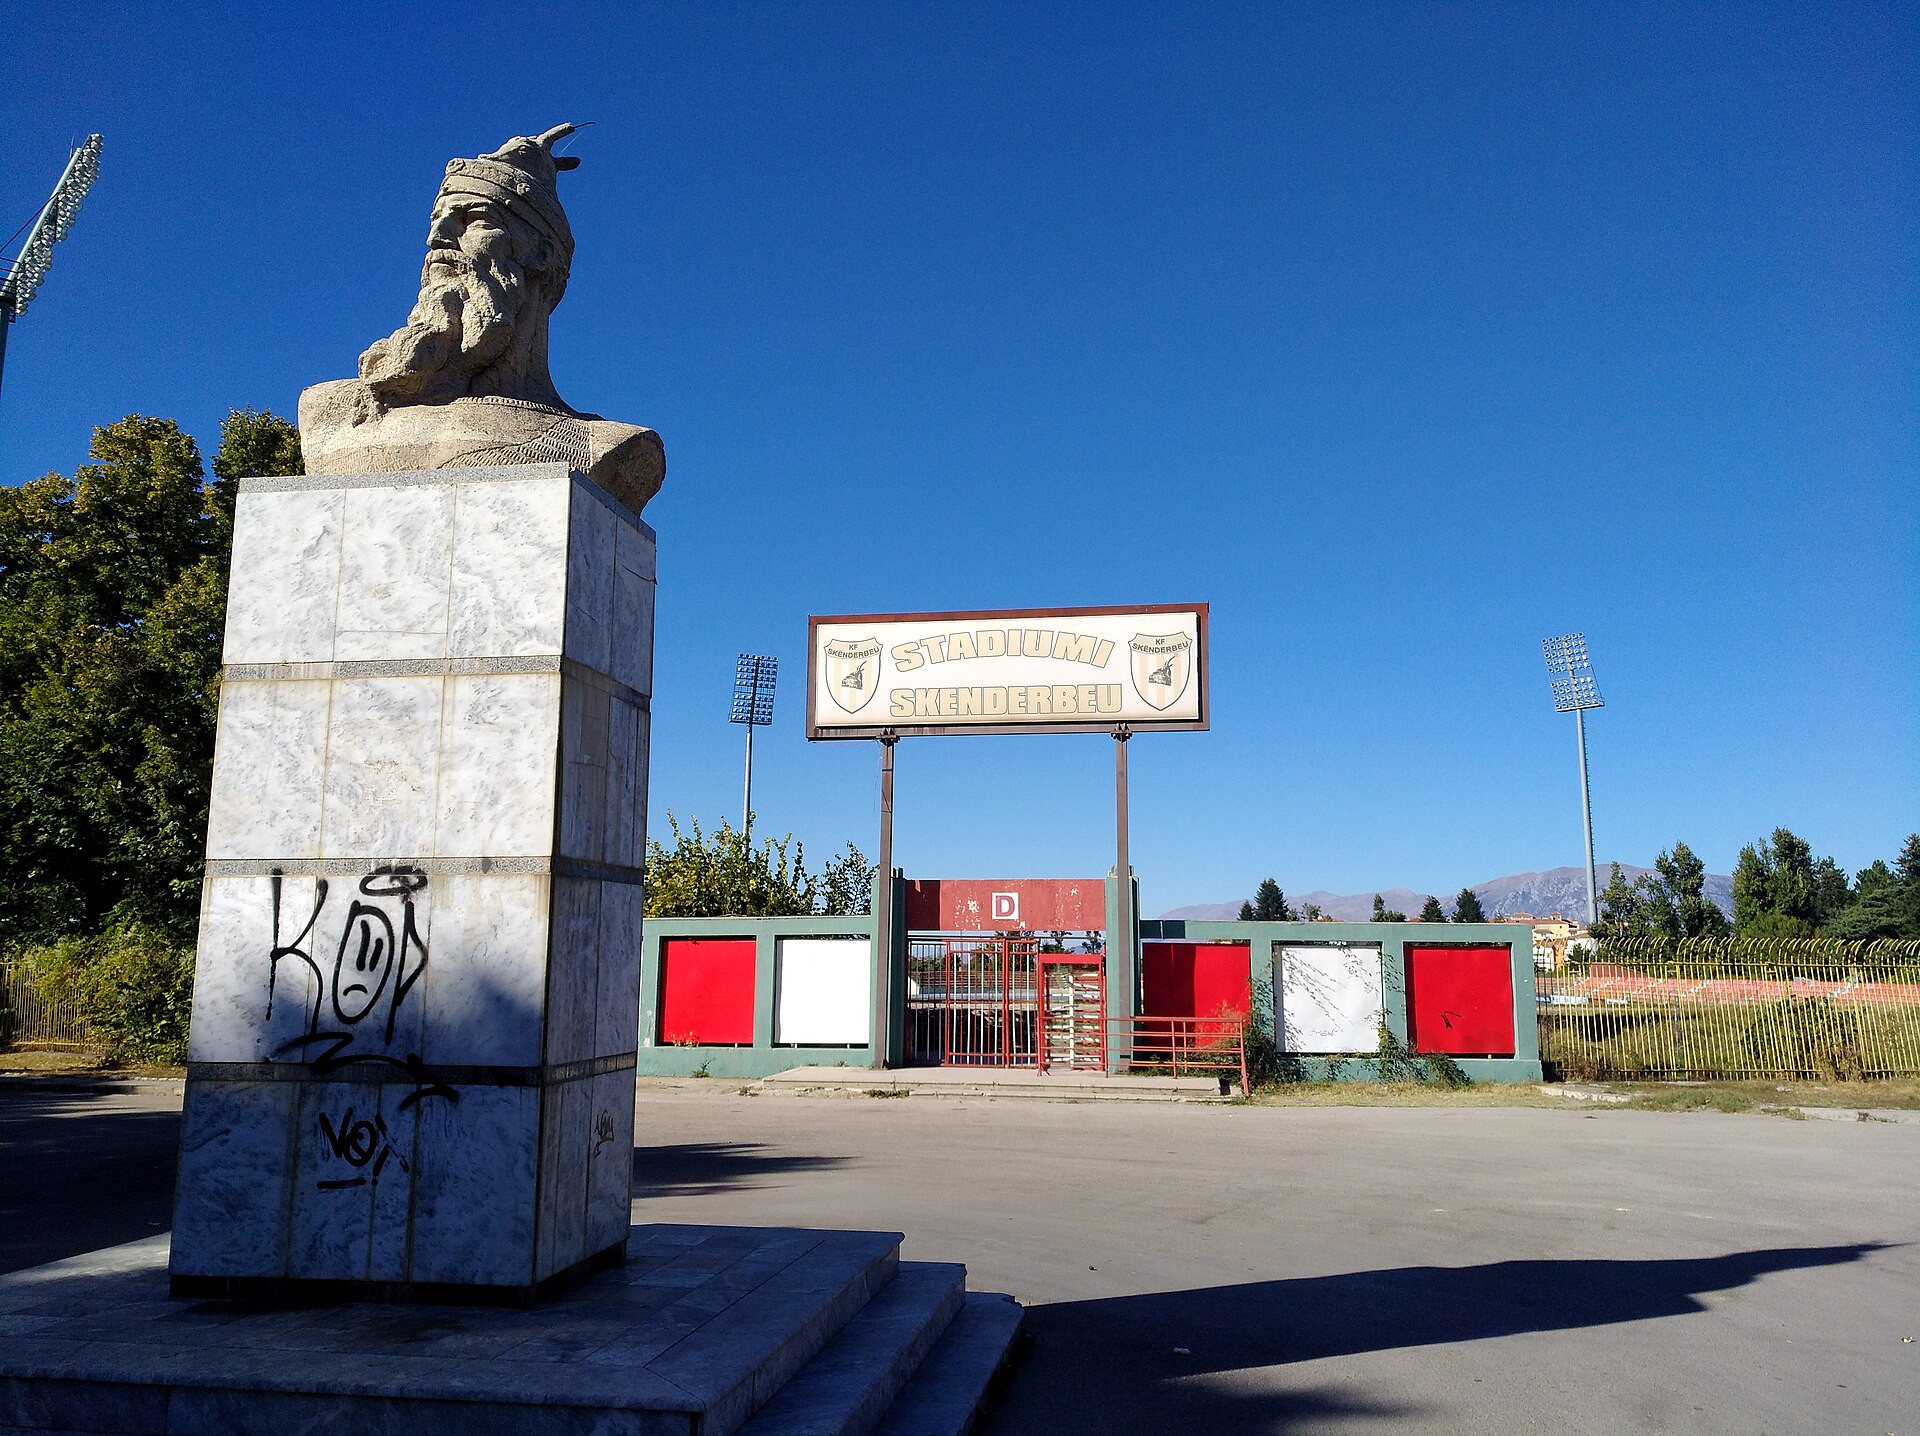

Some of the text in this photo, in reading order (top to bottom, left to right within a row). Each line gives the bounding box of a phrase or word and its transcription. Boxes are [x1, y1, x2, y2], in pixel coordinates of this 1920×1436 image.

[890, 629, 1115, 672] STADIUMI
[889, 683, 1121, 717] SKENDERBEU
[996, 895, 1015, 917] D
